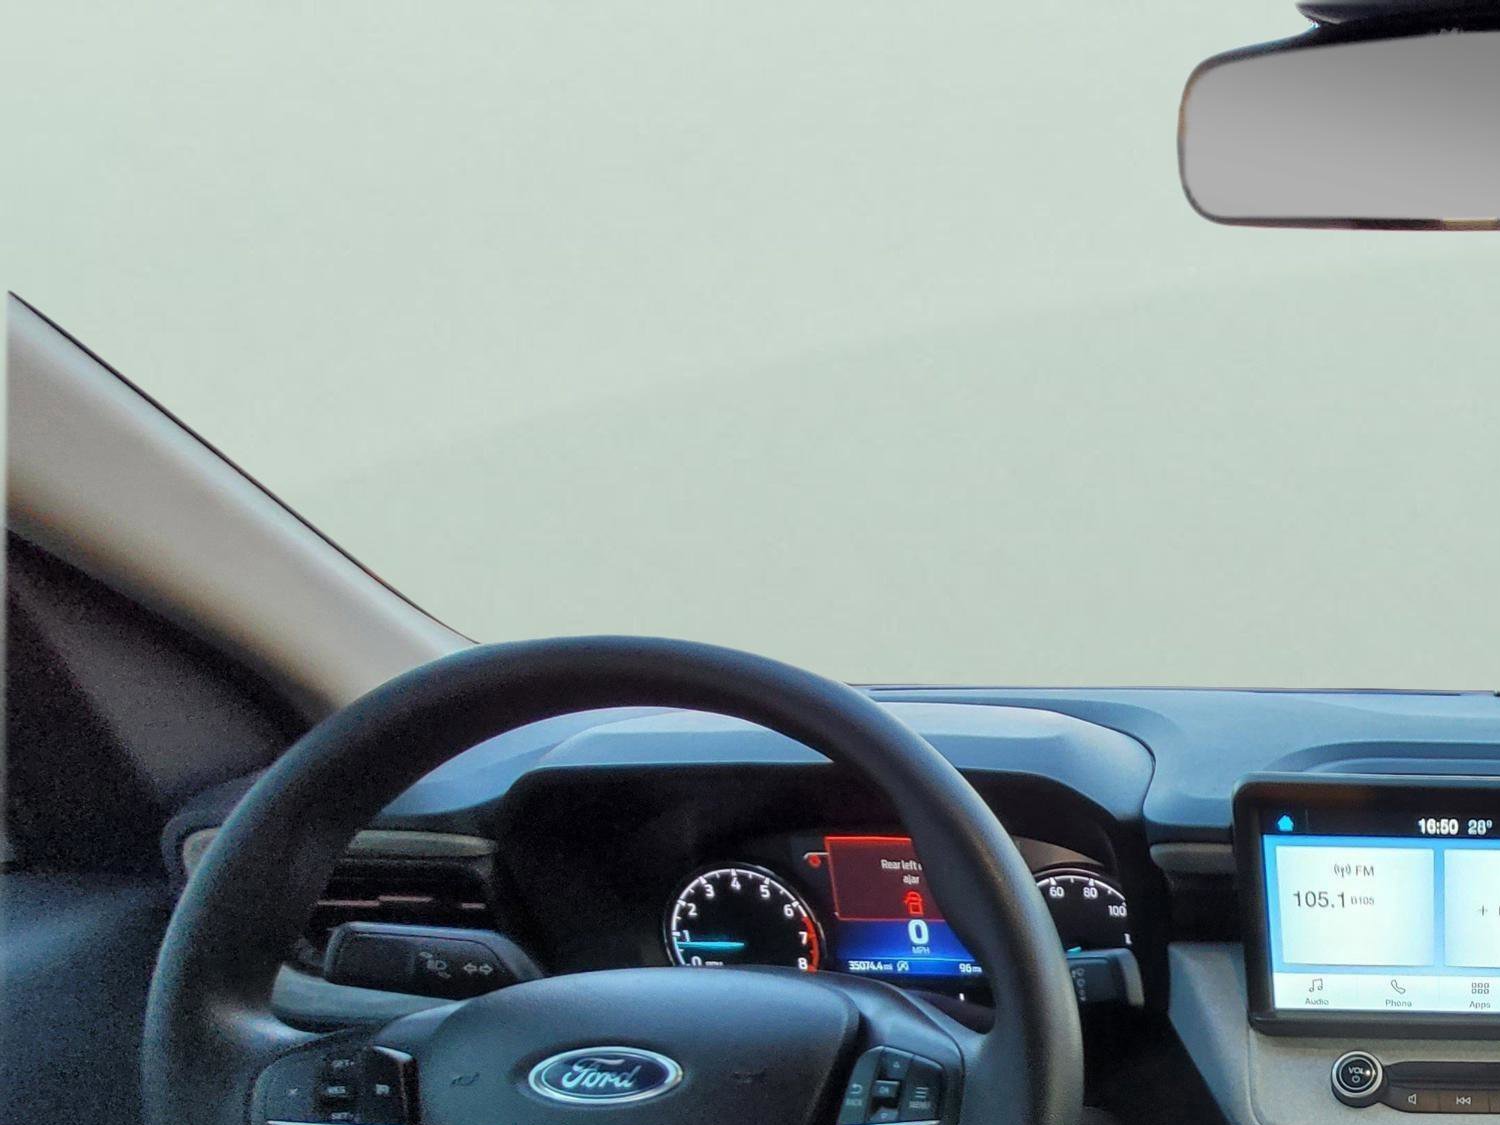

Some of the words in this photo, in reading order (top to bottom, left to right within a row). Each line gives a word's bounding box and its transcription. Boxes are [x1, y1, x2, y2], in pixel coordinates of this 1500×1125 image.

[1418, 818, 1459, 835] 16:50
[881, 859, 900, 869] Rear
[1355, 865, 1375, 877] FM
[730, 877, 742, 890] 4
[903, 874, 920, 885] ajar
[704, 884, 715, 897] 3
[759, 885, 771, 898] 5
[1049, 886, 1065, 898] 60
[1083, 887, 1099, 898] 80
[1293, 890, 1346, 908] 105.1
[687, 903, 698, 917] 2
[783, 904, 794, 917] 6
[1107, 904, 1127, 917] 100
[798, 931, 808, 945] 7
[908, 919, 929, 945] 0
[912, 946, 930, 955] MPH
[798, 957, 808, 970] 8
[848, 960, 883, 971] 35074.4
[959, 963, 972, 973] 96
[1305, 997, 1329, 1006] Audio
[1385, 999, 1412, 1008] Phone
[1469, 1001, 1491, 1010] Apps
[562, 1057, 642, 1089] Ford
[1348, 1066, 1365, 1075] VOL
